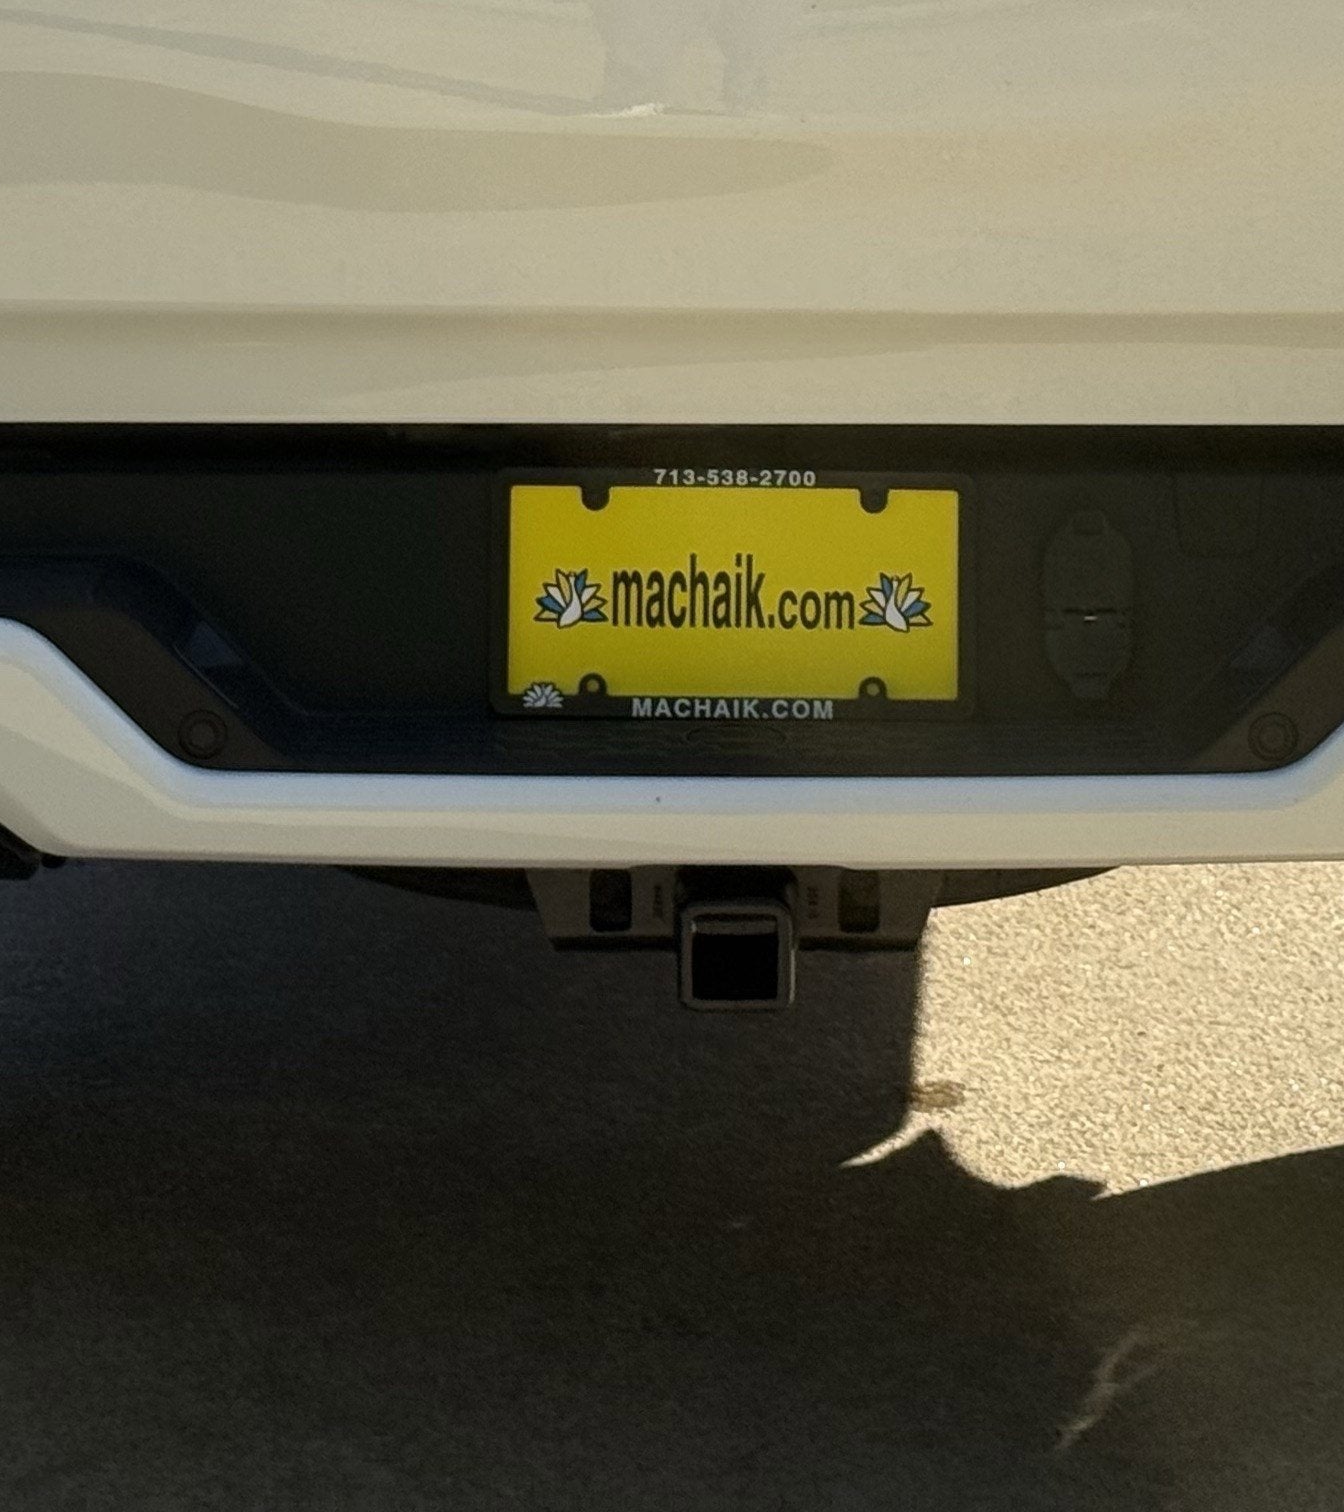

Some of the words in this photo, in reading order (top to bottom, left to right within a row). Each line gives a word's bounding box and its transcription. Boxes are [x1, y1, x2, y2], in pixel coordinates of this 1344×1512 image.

[654, 468, 816, 487] 713-538-2700
[611, 552, 855, 630] machaik.com
[631, 698, 834, 720] MACHAIK.COM
